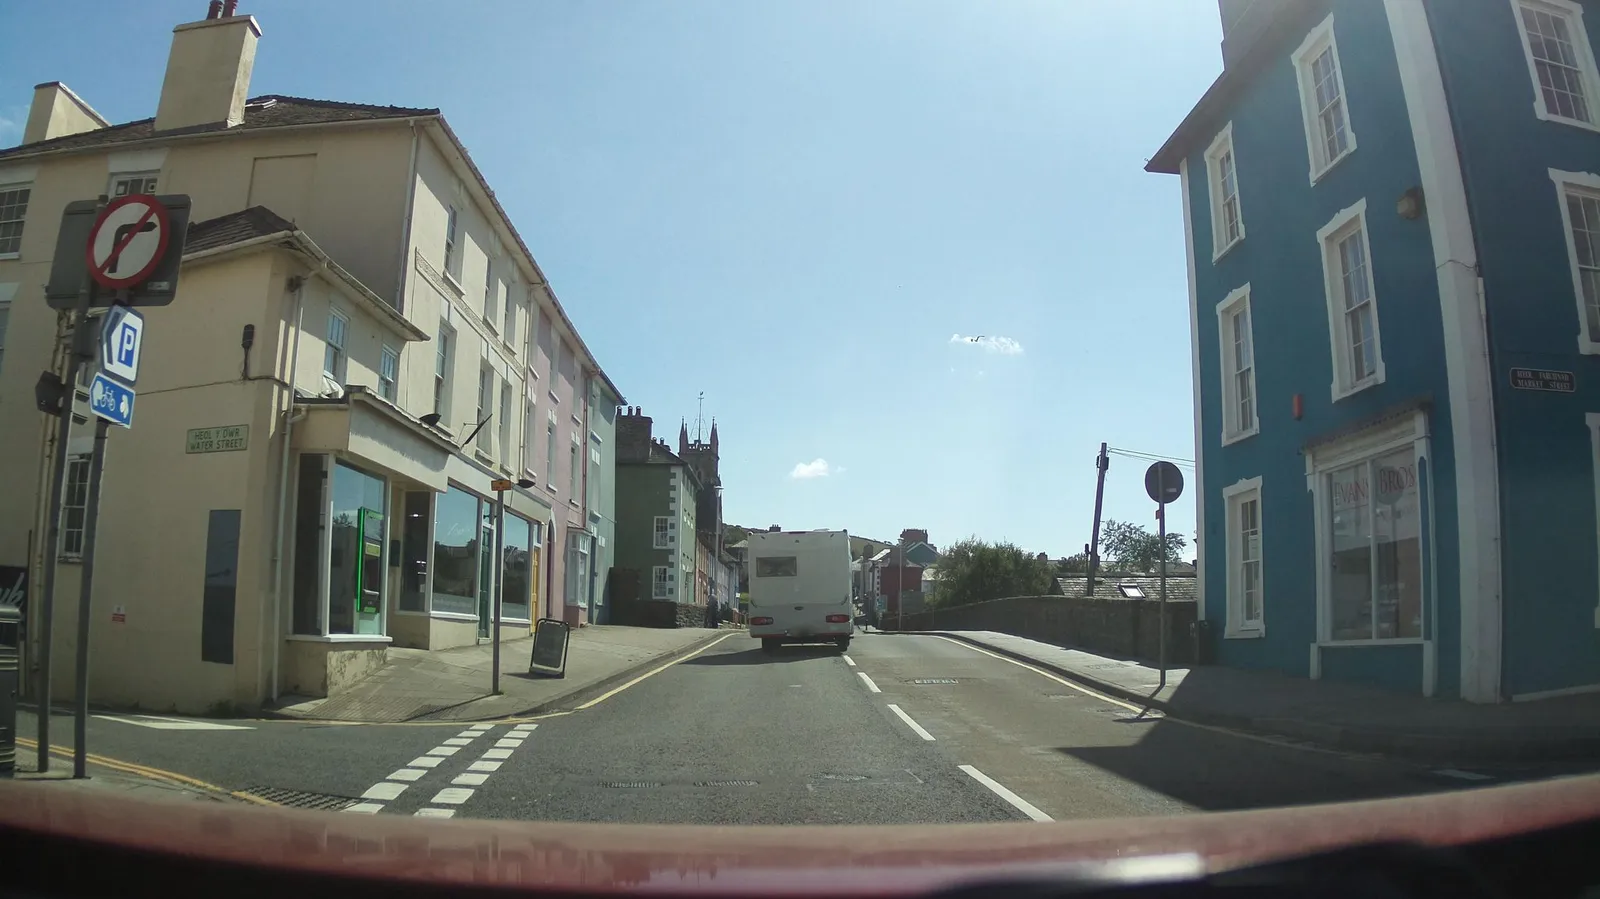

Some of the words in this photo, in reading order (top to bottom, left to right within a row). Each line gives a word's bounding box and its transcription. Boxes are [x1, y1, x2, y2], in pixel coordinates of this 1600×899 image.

[121, 327, 135, 362] P
[1517, 379, 1543, 388] MARKET
[1549, 381, 1571, 390] STREET
[195, 430, 212, 440] HEOL
[222, 427, 240, 438] DWR
[190, 440, 214, 450] WATER
[216, 438, 244, 450] STREET
[1380, 463, 1416, 495] BROS
